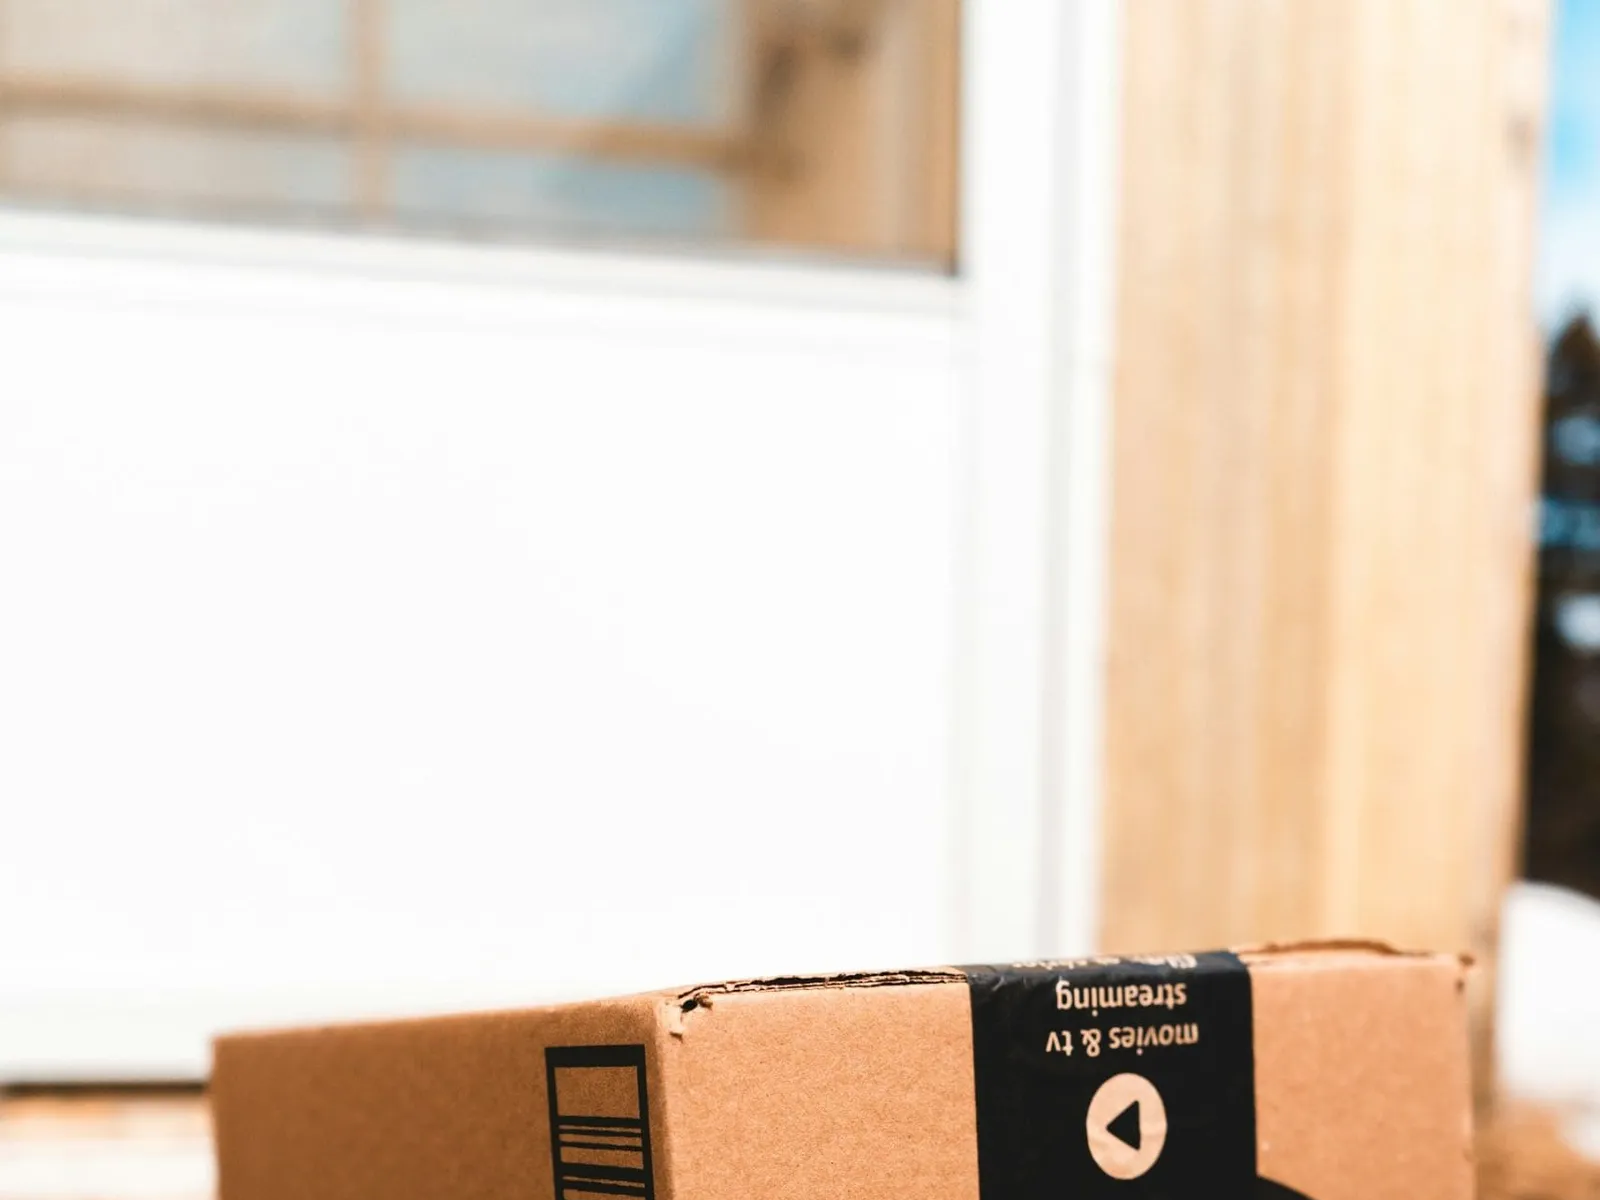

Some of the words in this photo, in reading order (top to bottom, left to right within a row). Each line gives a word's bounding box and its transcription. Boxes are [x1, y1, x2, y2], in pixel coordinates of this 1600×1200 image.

[1056, 981, 1187, 1017] streaming
[1046, 1031, 1073, 1056] tv
[1081, 1028, 1102, 1057] &
[1109, 1023, 1199, 1055] movies
